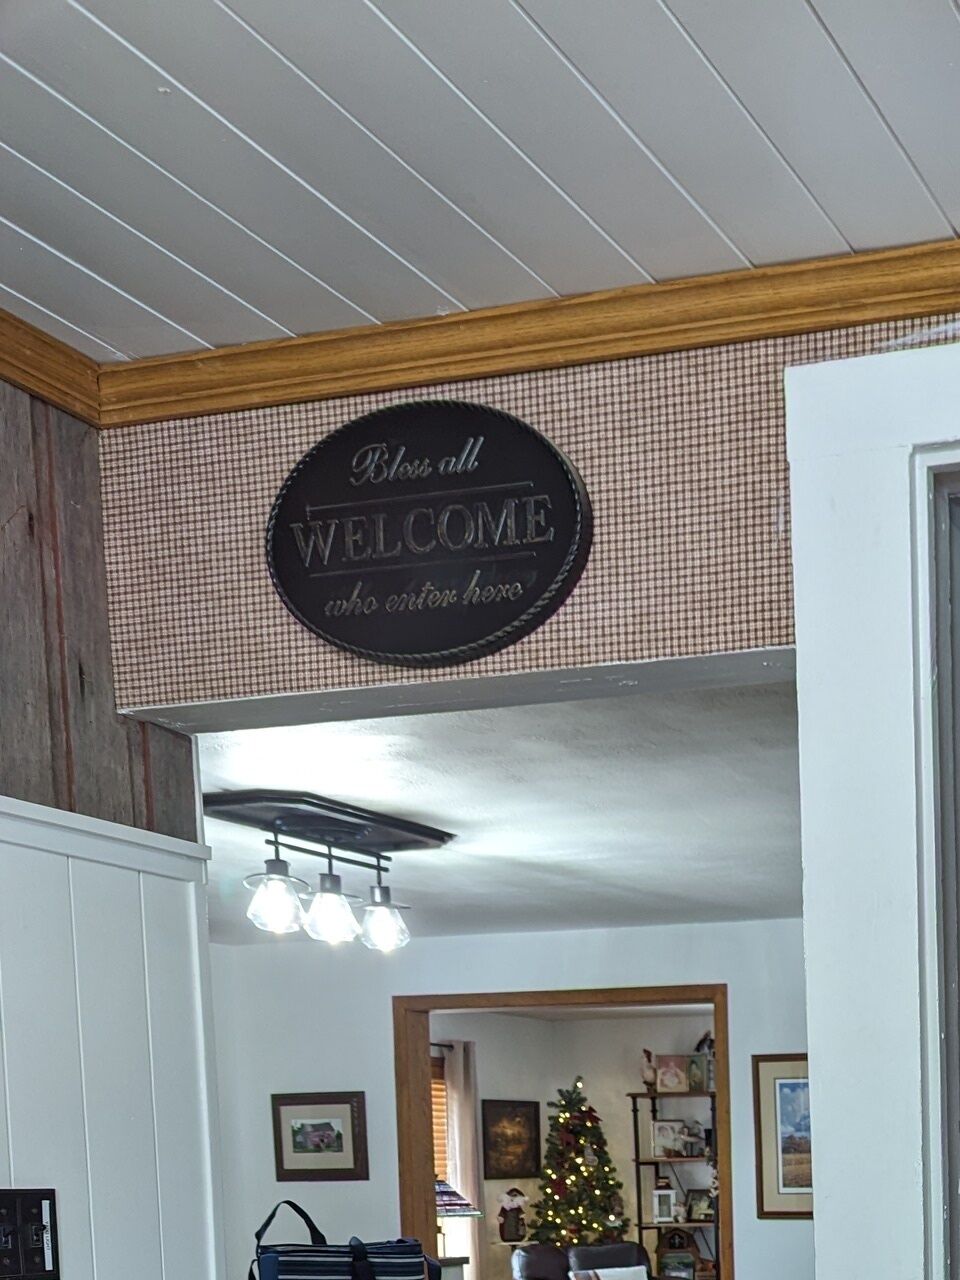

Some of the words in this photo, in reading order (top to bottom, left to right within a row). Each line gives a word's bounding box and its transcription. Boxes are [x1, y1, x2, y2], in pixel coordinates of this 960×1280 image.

[350, 443, 432, 486] Bless
[438, 436, 483, 475] all
[290, 494, 554, 568] WELCOME
[324, 581, 377, 617] who
[385, 581, 457, 613] enter
[462, 569, 523, 605] here
